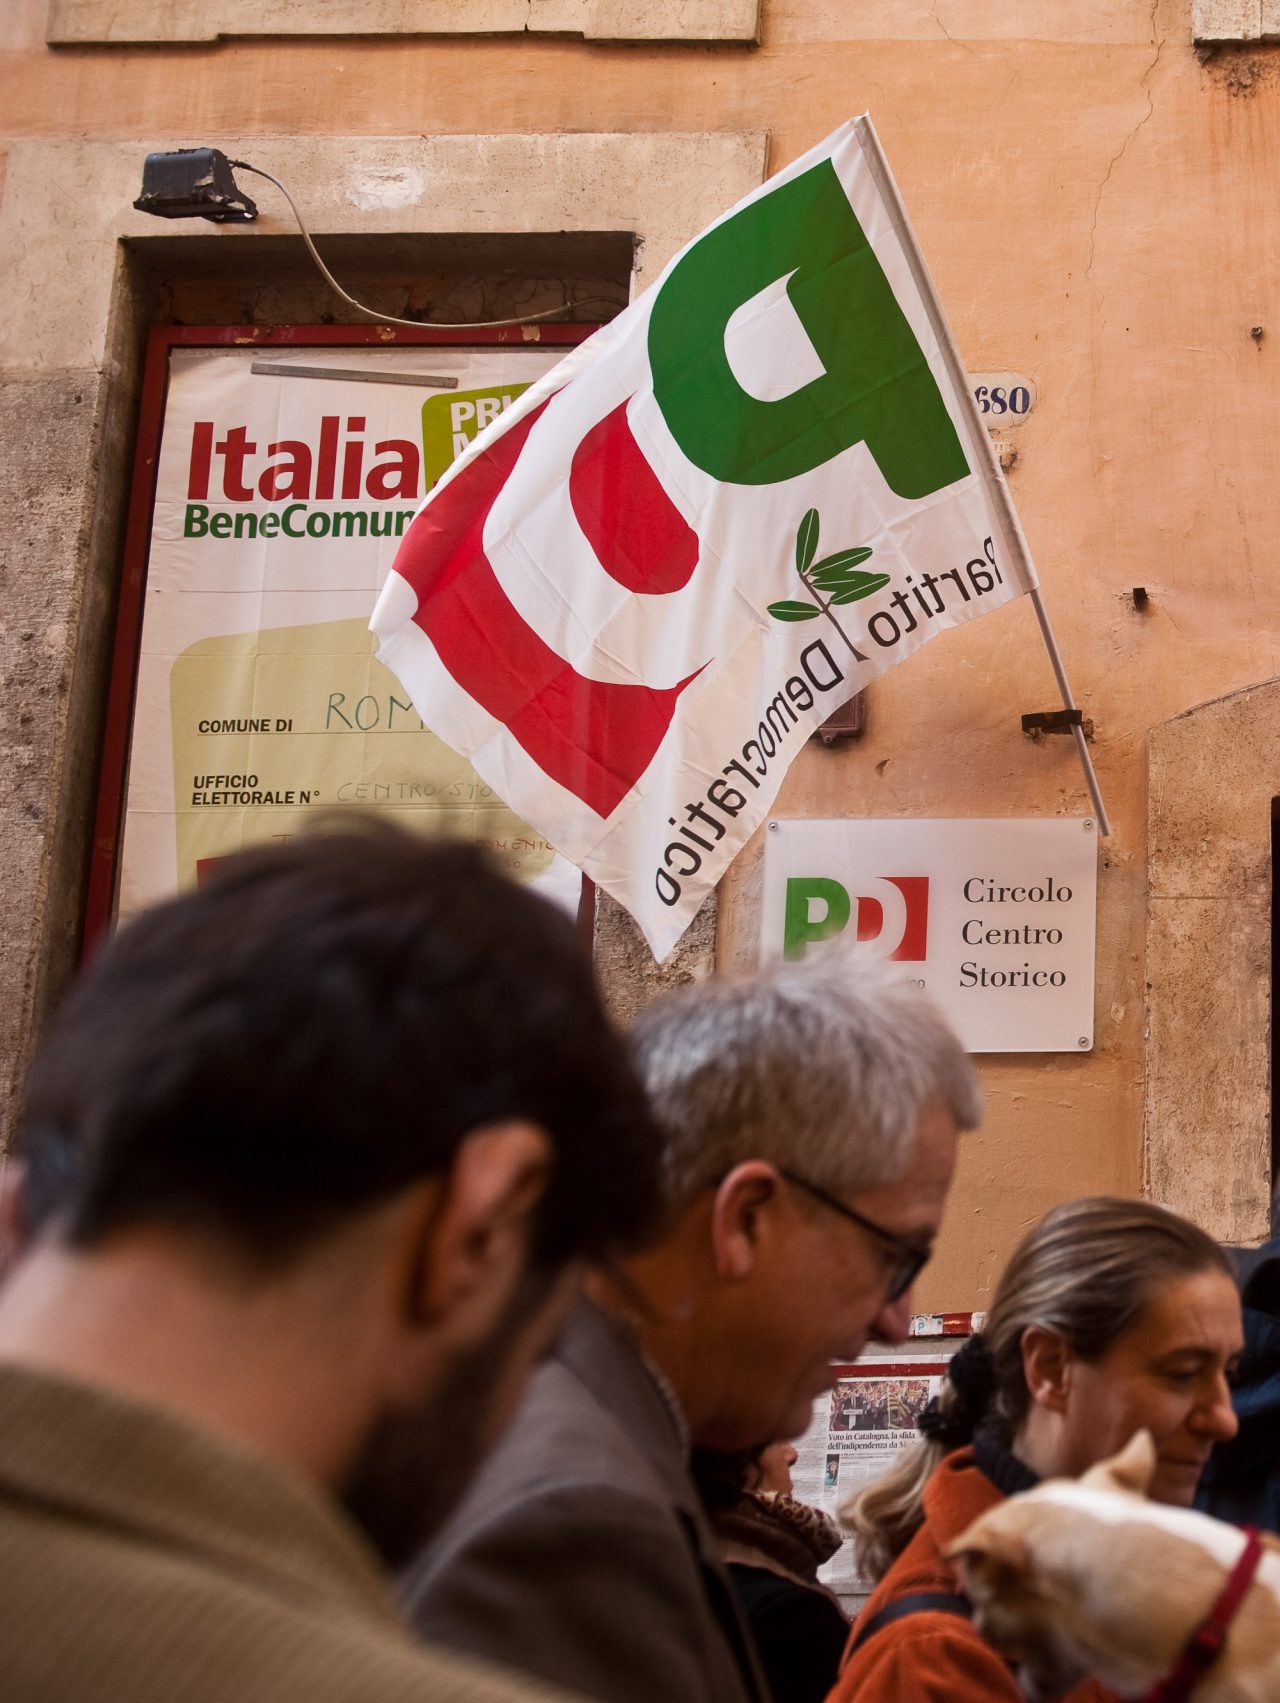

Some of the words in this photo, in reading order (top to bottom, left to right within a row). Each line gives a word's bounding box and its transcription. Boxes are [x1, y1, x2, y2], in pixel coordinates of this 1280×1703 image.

[974, 386, 1030, 414] 680
[187, 416, 420, 501] Italia
[183, 503, 416, 538] BeneComun
[326, 692, 428, 731] ROM
[198, 719, 270, 734] COMUNE
[275, 719, 293, 733] DI
[193, 774, 259, 789] UFFICIO
[191, 791, 295, 806] ELETTORALE
[963, 877, 1073, 903] Circolo
[783, 876, 929, 962] PD
[961, 919, 1064, 946] Centro
[959, 961, 1067, 988] Storico
